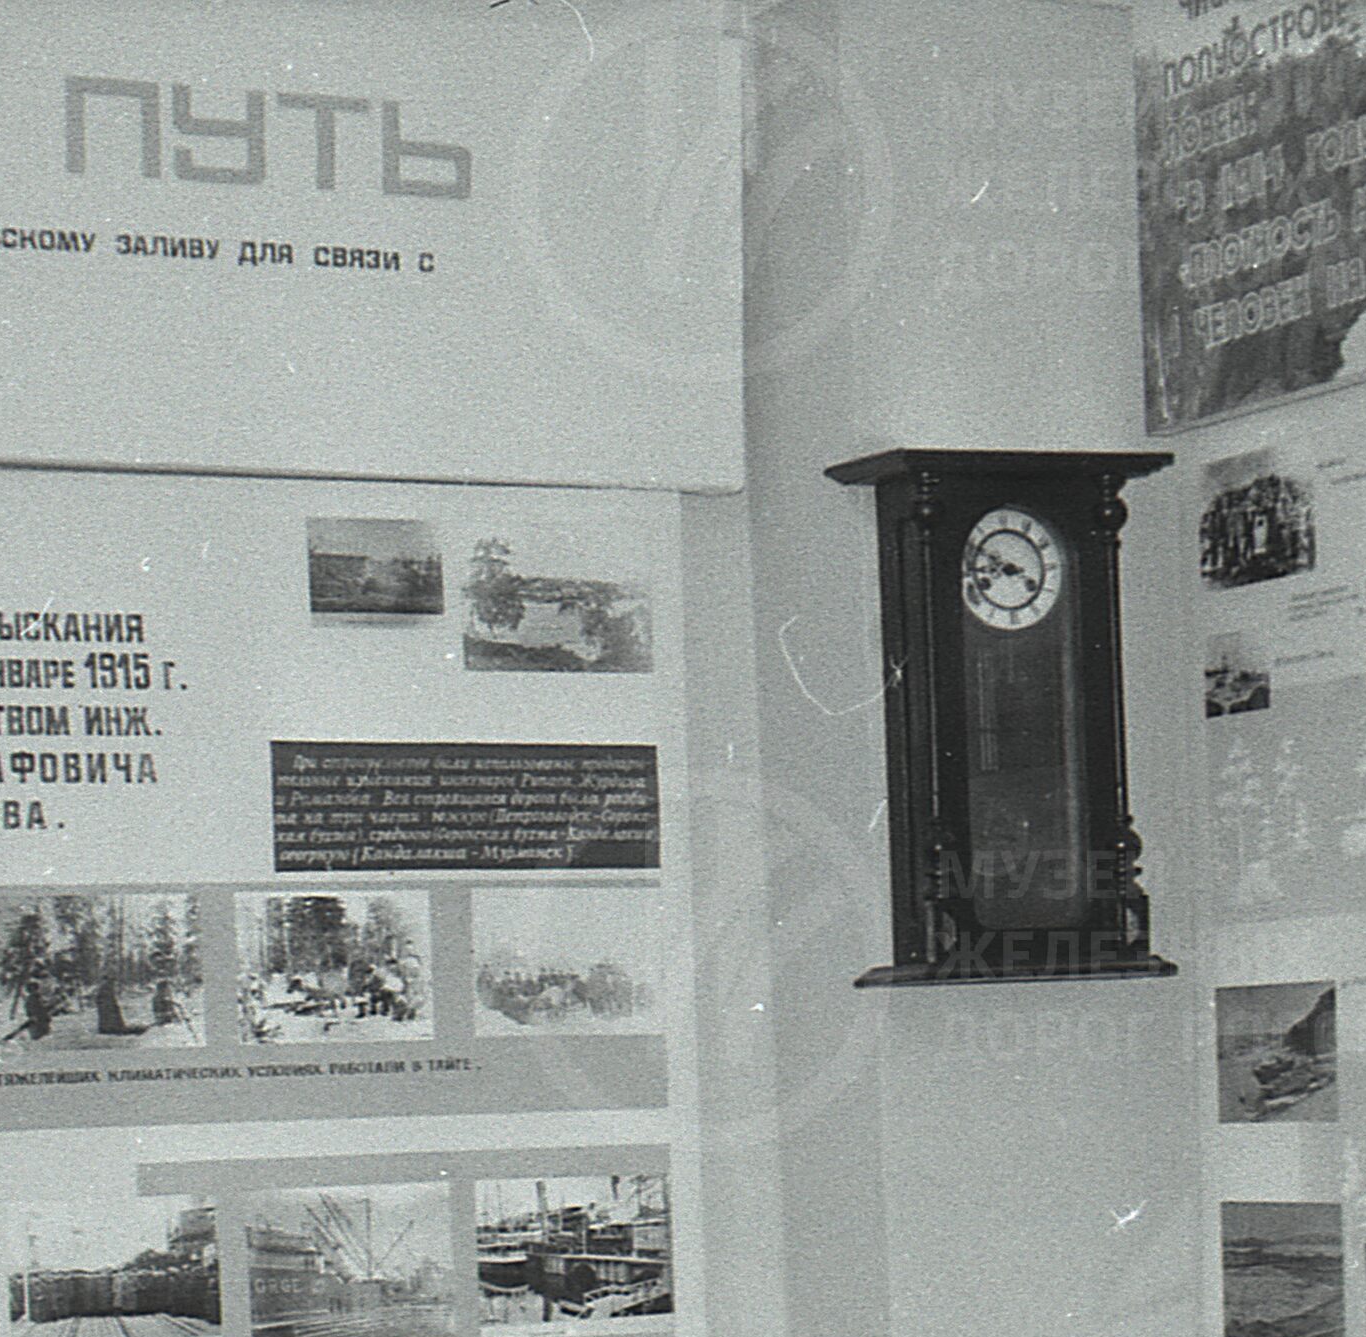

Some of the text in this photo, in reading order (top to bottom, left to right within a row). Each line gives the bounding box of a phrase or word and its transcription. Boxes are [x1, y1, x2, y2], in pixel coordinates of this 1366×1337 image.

[64, 76, 473, 200] ПУТЬ
[115, 233, 221, 263] ЗАЛИВУ
[237, 240, 294, 268] ДЛЯ
[313, 246, 401, 272] СВЯЗИ
[418, 251, 436, 274] С
[84, 651, 151, 691] 1915
[84, 705, 164, 738] ИНЖ.
